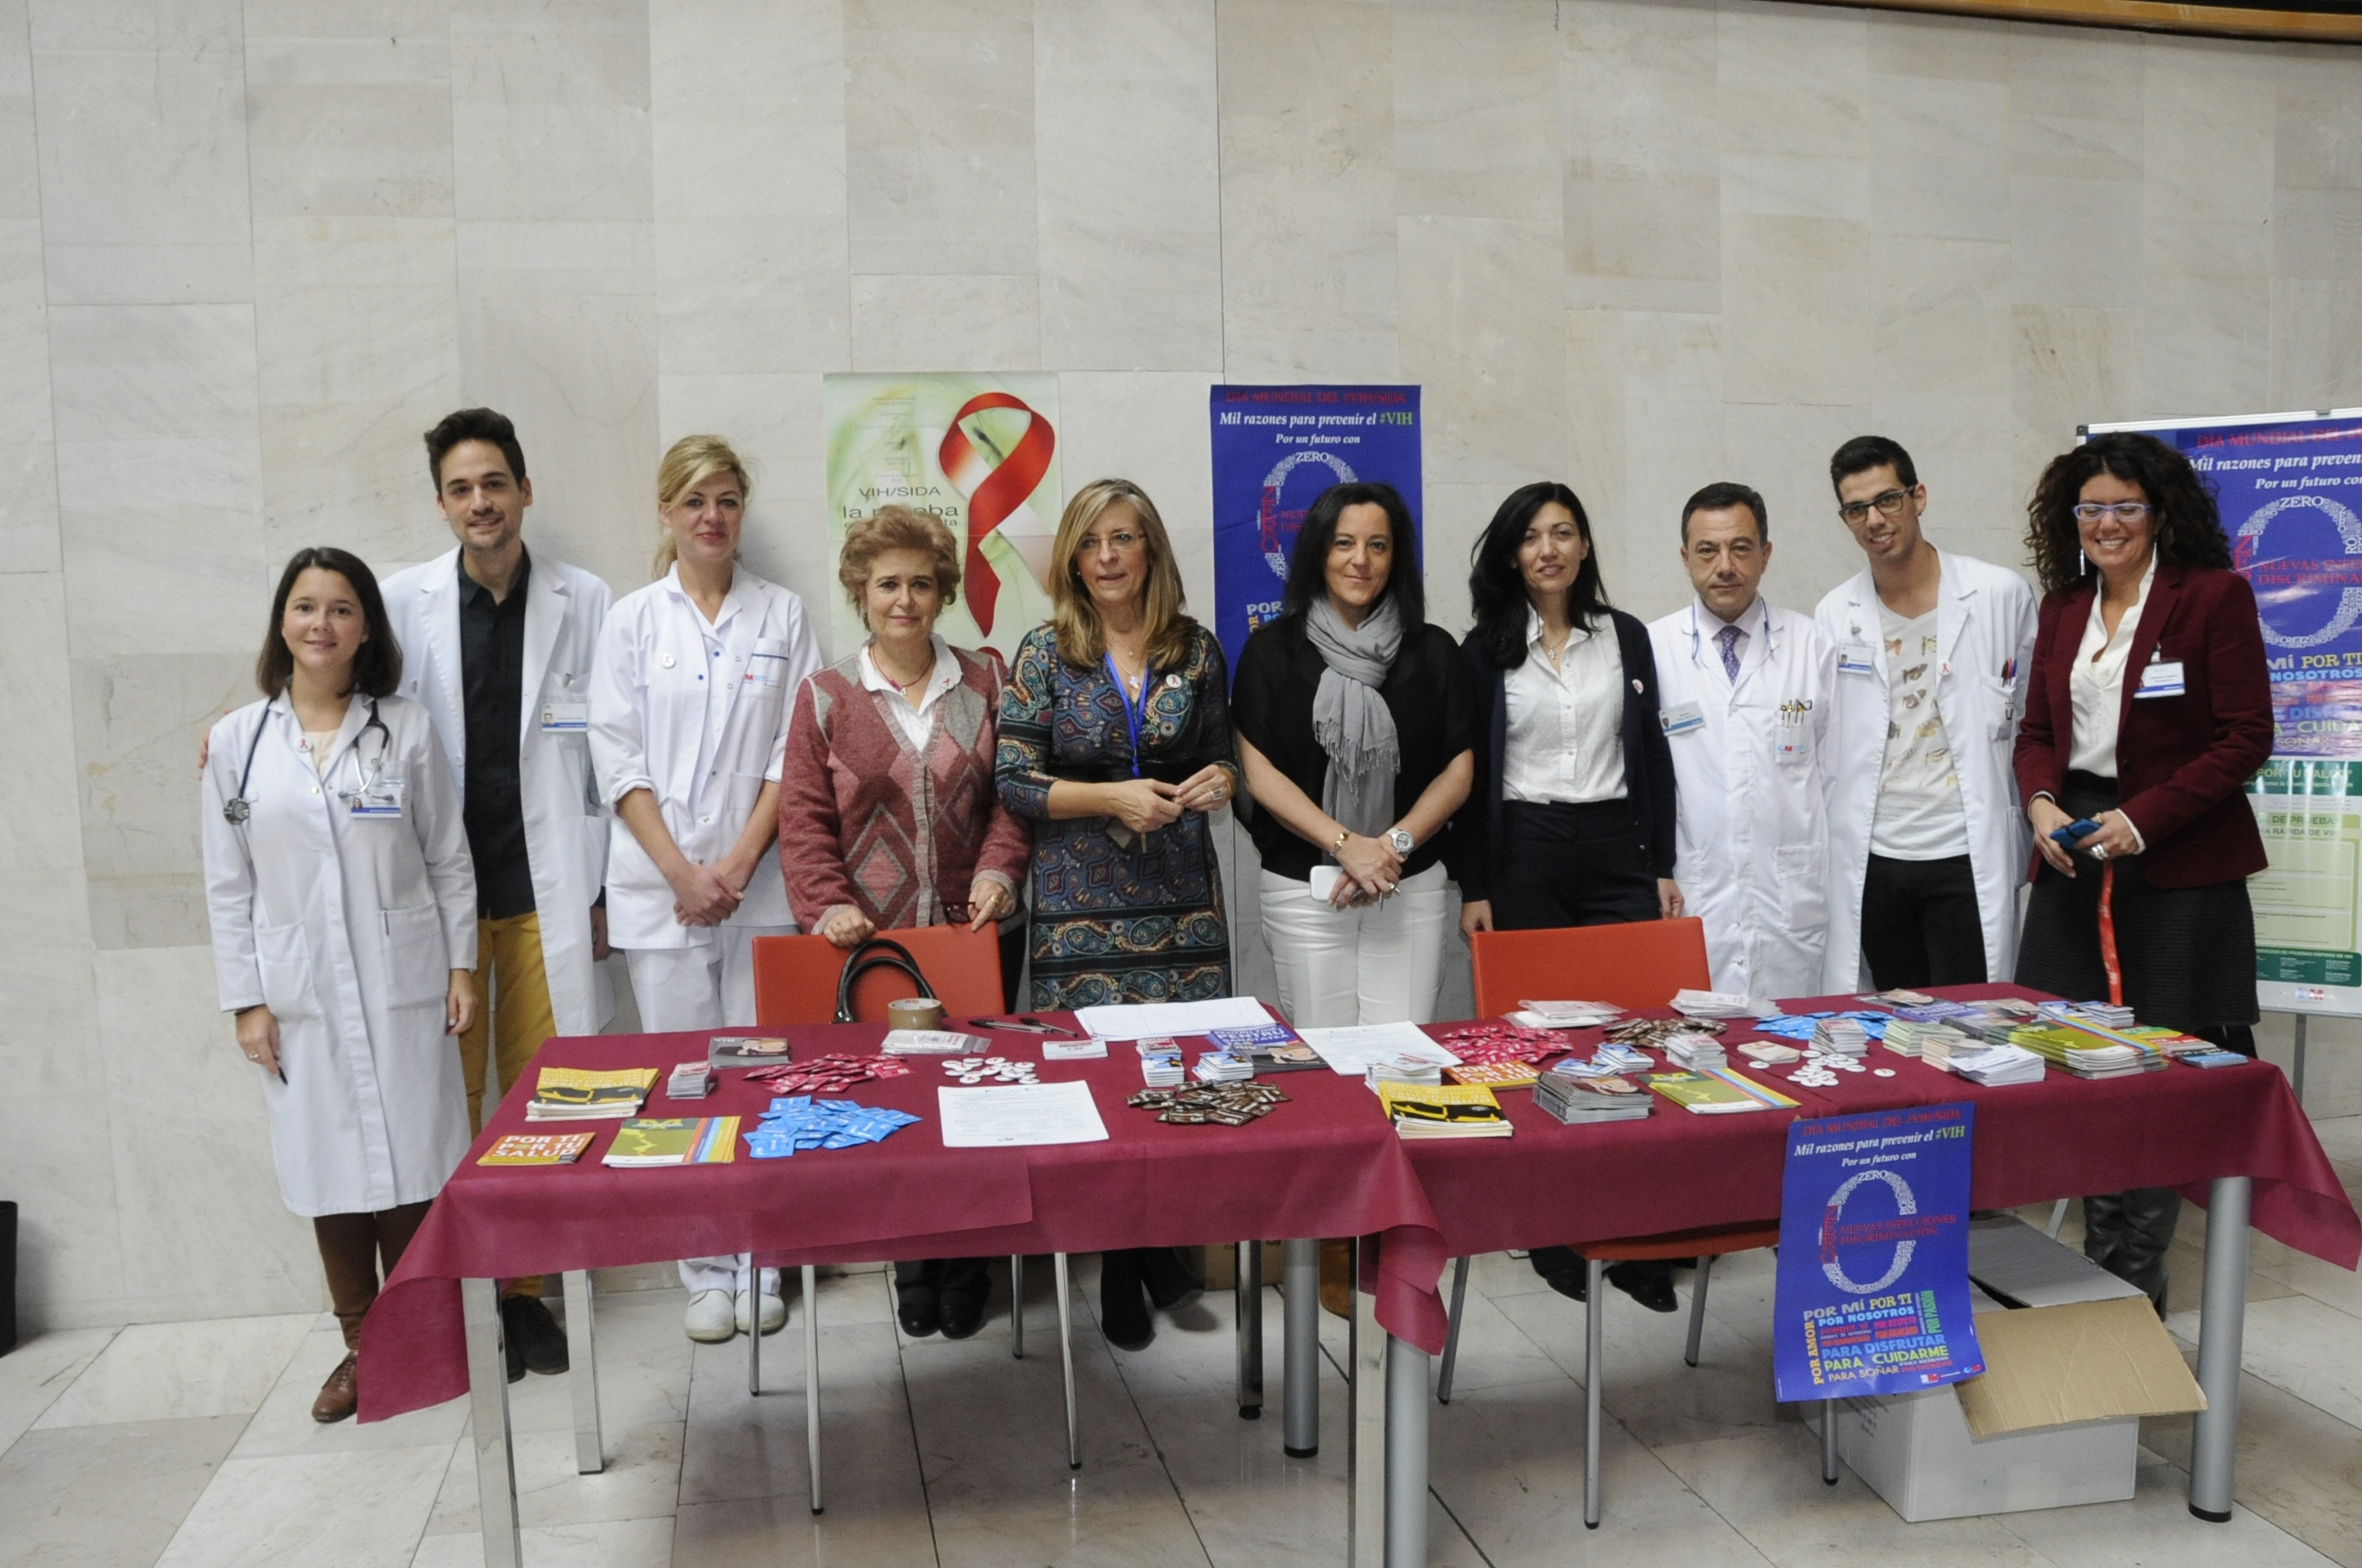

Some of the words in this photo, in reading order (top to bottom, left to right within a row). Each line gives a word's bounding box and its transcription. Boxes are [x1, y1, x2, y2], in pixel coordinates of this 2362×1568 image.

[1219, 412, 1241, 425] Mil
[1244, 415, 1287, 425] razones
[1289, 415, 1316, 428] para
[1318, 412, 1365, 429] prevenir
[1366, 412, 1377, 425] el
[1380, 412, 1413, 425] #VIH
[1275, 434, 1294, 444] Por
[1309, 434, 1341, 447] futuro
[1296, 451, 1329, 462] ZERO
[2190, 457, 2214, 471] Mil
[2216, 457, 2271, 471] razones
[2274, 456, 2308, 472] para
[2255, 478, 2279, 490] Por
[2281, 479, 2297, 488] un
[2298, 476, 2341, 490] futuro
[859, 486, 941, 497] VIH/SIDA
[2280, 496, 2324, 507] ZERO
[843, 506, 862, 518] la
[1246, 601, 1284, 615] POR
[2301, 654, 2340, 669] POR
[2272, 815, 2286, 824] DE
[504, 1135, 552, 1144] POR
[553, 1141, 583, 1150] TU
[1794, 1143, 1814, 1156] Mil
[1816, 1141, 1855, 1154] razones
[1855, 1139, 1879, 1152] para
[1880, 1133, 1923, 1149] prevenir
[1923, 1129, 1934, 1142] el
[1935, 1125, 1966, 1140] #VIH
[491, 1148, 578, 1157] SALUD
[1841, 1157, 1858, 1168] Por
[1871, 1153, 1900, 1167] futuro
[1900, 1151, 1917, 1160] con
[1857, 1170, 1888, 1181] ZERO
[1804, 1306, 1838, 1321] POR
[1869, 1295, 1896, 1310] POR
[1898, 1293, 1912, 1305] TI
[1818, 1316, 1844, 1327] POR
[1848, 1307, 1915, 1323] NOSOTROS
[1804, 1319, 1818, 1357] AMOR
[1822, 1345, 1862, 1359] PARA
[1864, 1334, 1947, 1354] DISFRUTAR
[1823, 1357, 1864, 1372] PARA
[1872, 1346, 1949, 1364] CUIDARME
[1810, 1358, 1825, 1386] POR
[1827, 1371, 1857, 1382] PARA
[1859, 1364, 1900, 1379] SOÑAR
